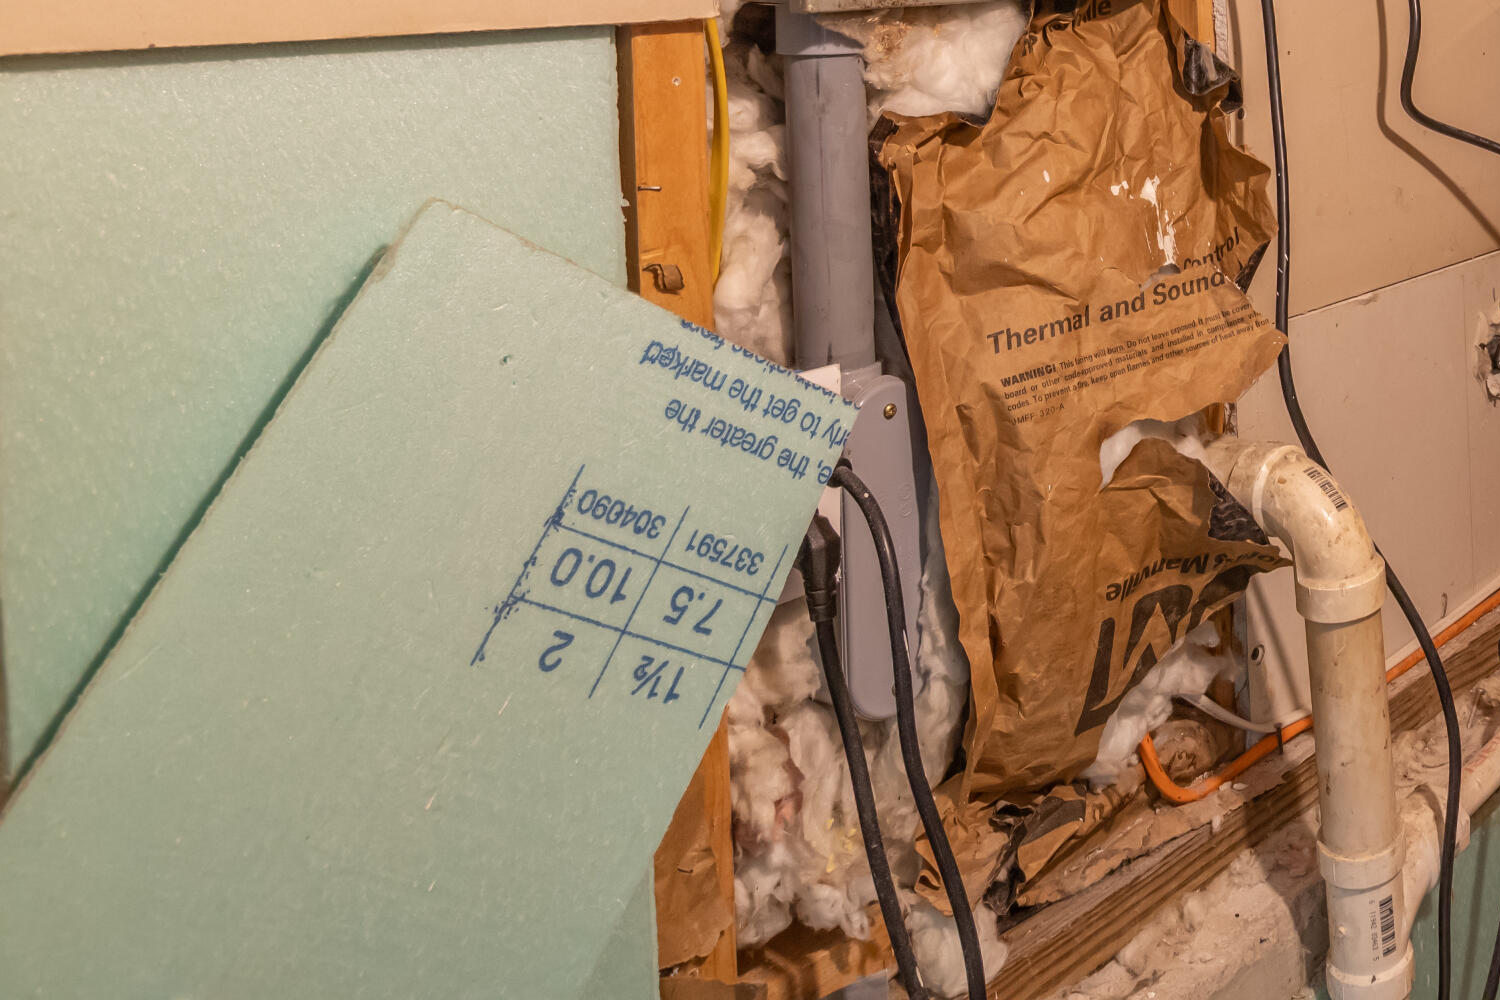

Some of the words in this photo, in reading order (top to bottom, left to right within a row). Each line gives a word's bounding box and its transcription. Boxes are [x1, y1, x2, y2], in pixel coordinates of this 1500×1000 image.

[986, 304, 1090, 355] Thermal
[1099, 283, 1146, 323] and
[1152, 271, 1226, 306] Sound
[639, 340, 728, 392] marked
[1000, 363, 1057, 388] WARNING!
[1004, 386, 1027, 400] board
[1030, 384, 1039, 392] or
[1151, 342, 1164, 353] and
[664, 399, 702, 434] the
[728, 377, 763, 412] the
[762, 394, 801, 424] get
[701, 416, 779, 460] greater
[800, 411, 822, 440] to
[777, 447, 810, 480] the
[577, 489, 667, 540] 304090
[685, 529, 765, 576] 337591
[550, 547, 633, 605] 10.0
[1105, 552, 1210, 603] Manville
[663, 585, 724, 636] 7.5
[538, 630, 575, 672] 2
